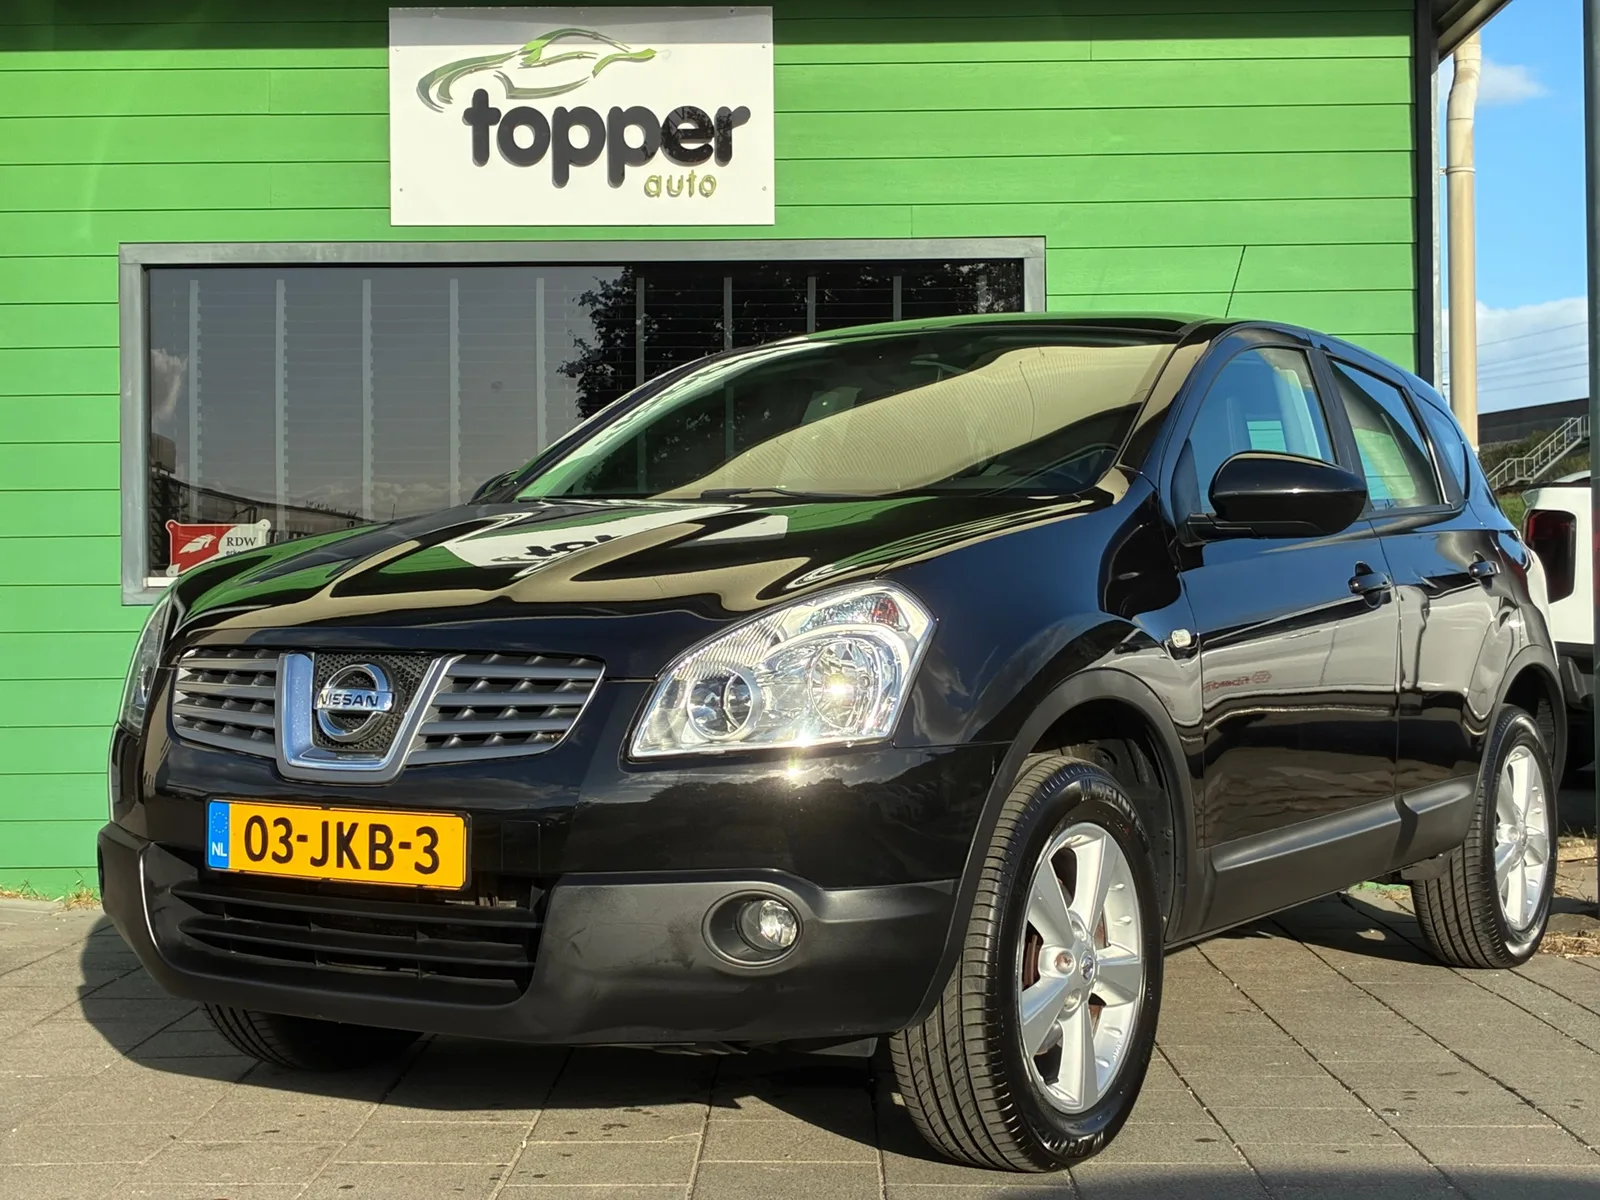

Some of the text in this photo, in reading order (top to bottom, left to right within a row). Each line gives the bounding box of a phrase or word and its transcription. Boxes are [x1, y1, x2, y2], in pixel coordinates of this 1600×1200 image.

[463, 88, 751, 188] topper
[644, 170, 717, 198] auto
[226, 536, 257, 547] RDW
[318, 693, 379, 707] NISSAN
[211, 842, 228, 857] NL
[244, 815, 440, 875] 03-JKB-3
